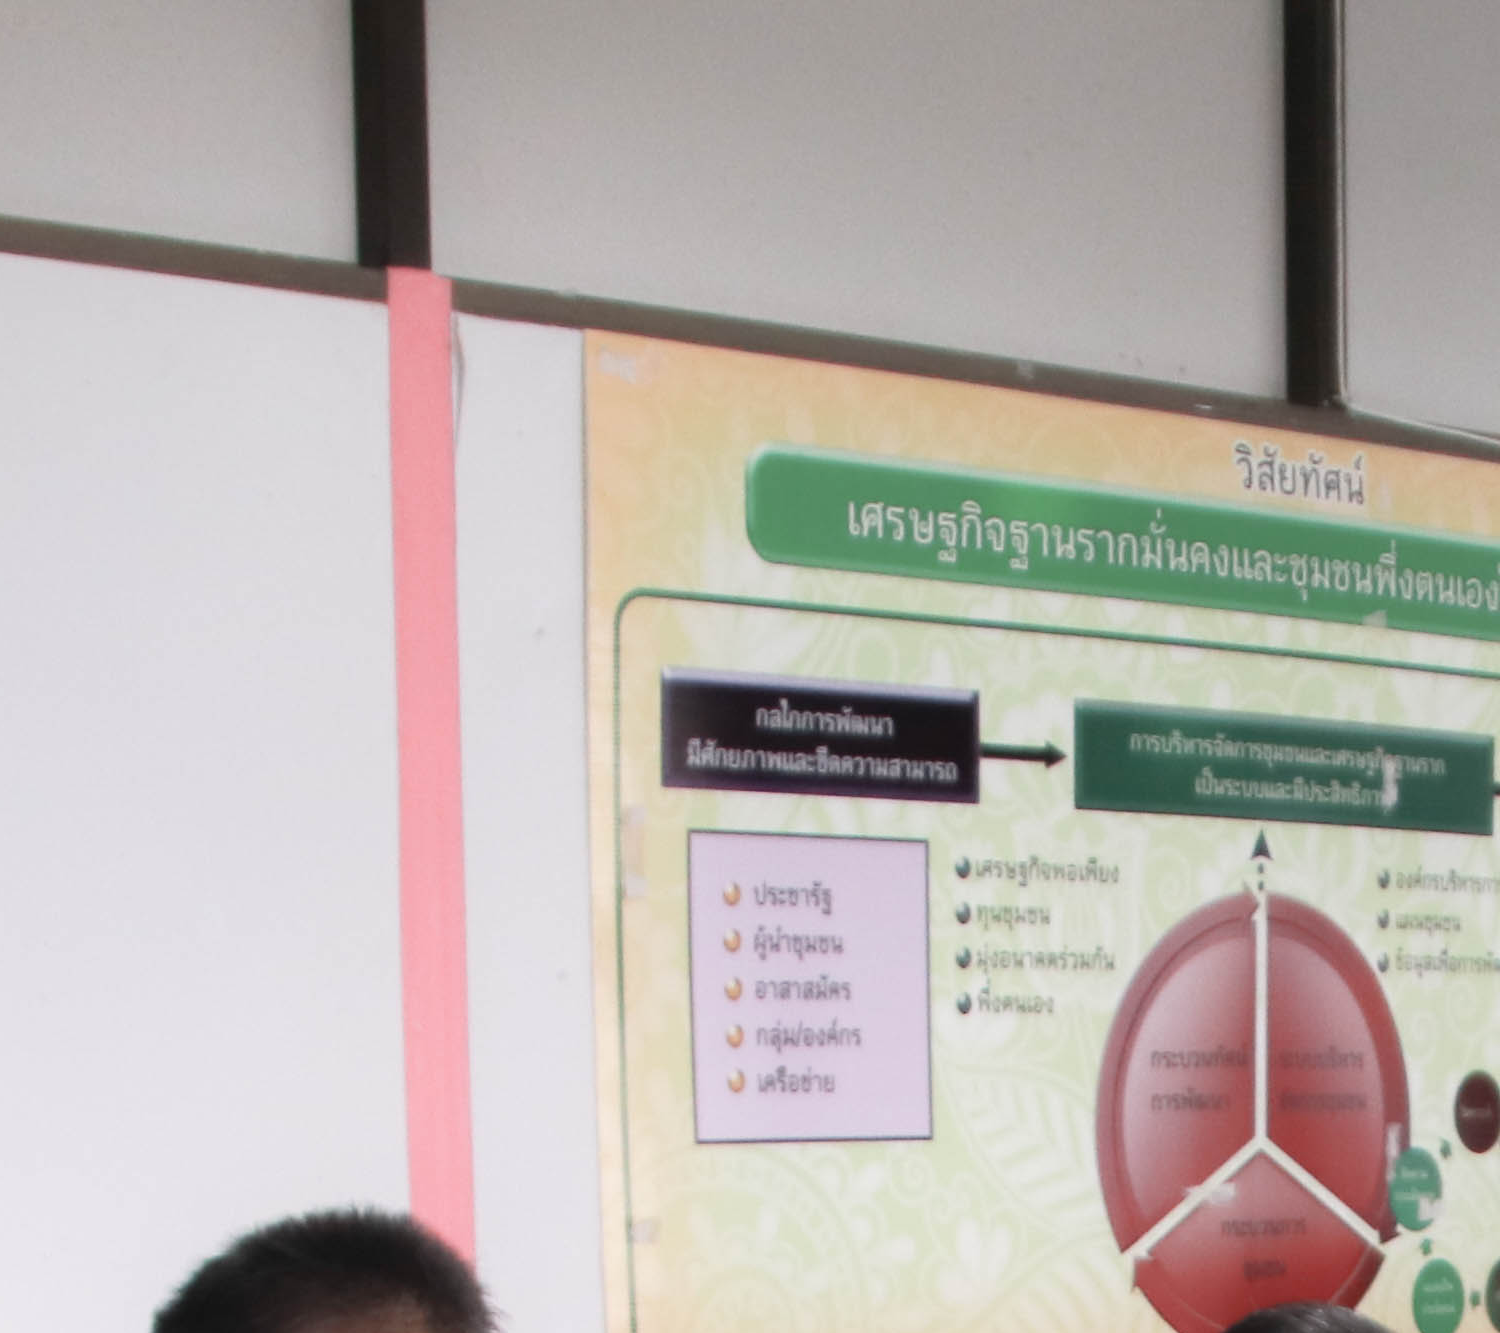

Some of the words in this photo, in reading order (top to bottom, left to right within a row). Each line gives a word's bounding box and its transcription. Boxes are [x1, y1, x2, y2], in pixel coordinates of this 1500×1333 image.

[1234, 441, 1365, 505] วิสัยทัศน์
[755, 699, 895, 737] กลไกการพัฒนา
[975, 854, 1120, 888] เศรษฐกิจพอเพียง
[752, 882, 832, 915] ประชารัฐ
[976, 904, 1051, 933] ทุนชุมชน
[752, 927, 844, 960] ผู้นำชุมชน
[975, 946, 1116, 974] มุ่งอนาคตร่วมกัน
[755, 976, 852, 1001] อาสาสมัคร
[756, 1024, 862, 1055] กลุ่ม/องค์กร
[757, 1067, 835, 1094] เครือข่าย
